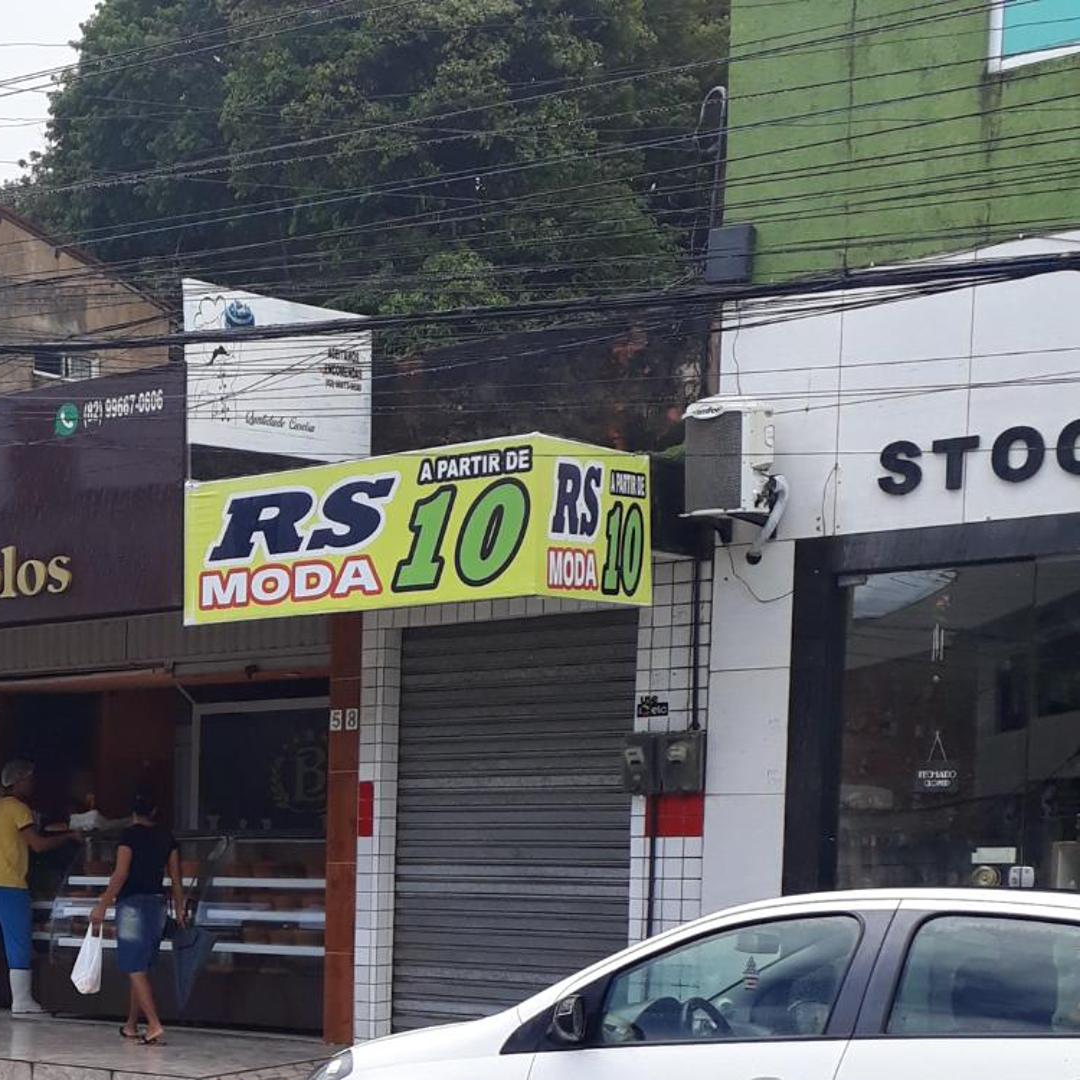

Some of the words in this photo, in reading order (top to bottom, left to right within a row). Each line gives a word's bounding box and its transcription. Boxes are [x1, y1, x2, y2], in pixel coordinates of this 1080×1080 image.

[83, 400, 103, 428] (82)
[418, 461, 433, 482] A
[436, 452, 500, 479] PARTIR
[505, 447, 532, 471] DE
[616, 472, 636, 495] PARTIR
[206, 475, 398, 563] RS
[550, 461, 603, 537] RS
[392, 477, 532, 593] 10
[602, 501, 645, 597] 10
[200, 556, 382, 609] MODA
[548, 548, 598, 589] MODA
